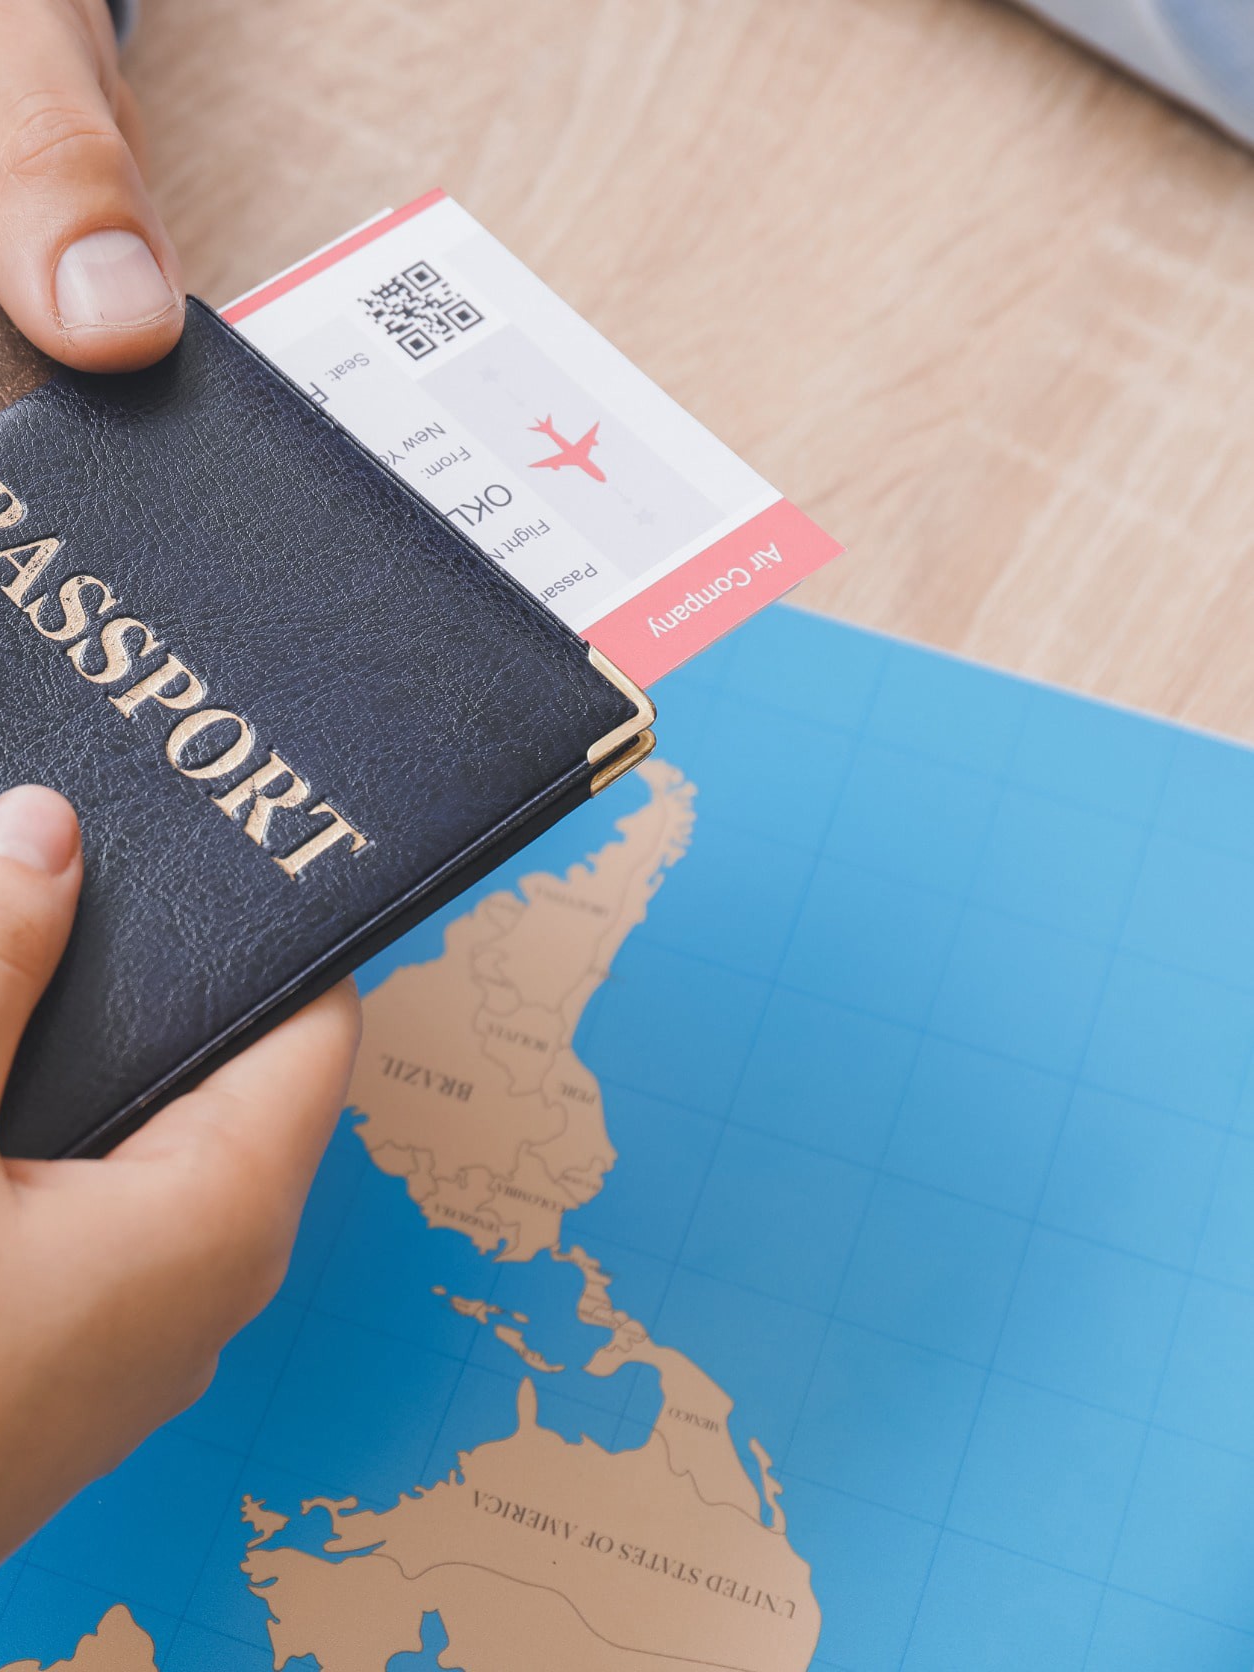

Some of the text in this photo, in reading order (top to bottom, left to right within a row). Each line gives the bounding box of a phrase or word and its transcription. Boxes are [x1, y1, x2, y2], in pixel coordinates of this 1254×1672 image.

[324, 352, 370, 381] Seat:
[402, 421, 446, 452] New
[420, 446, 471, 479] From:
[445, 484, 513, 527] OKL
[503, 518, 551, 551] Flight
[646, 542, 783, 638] Air Company
[381, 1054, 475, 1102] BRAZIL
[667, 1407, 720, 1434] MEXICO
[473, 1489, 797, 1620] UNITED STATES OF AMERICA
